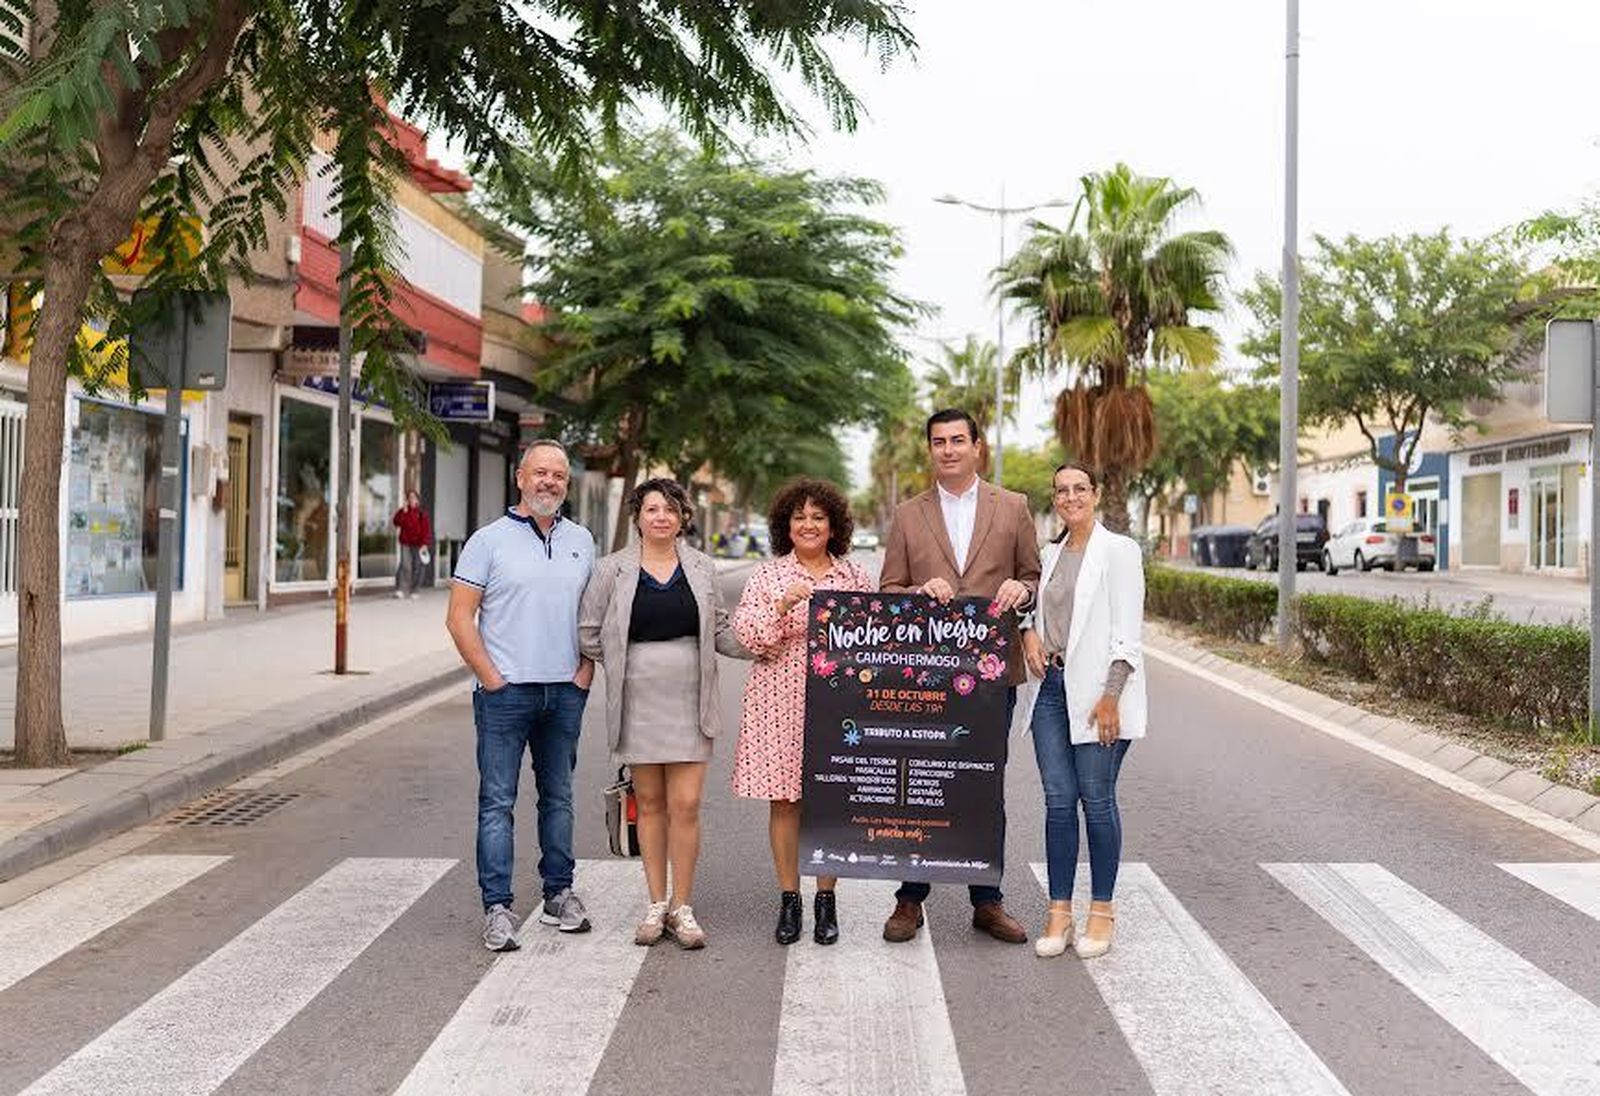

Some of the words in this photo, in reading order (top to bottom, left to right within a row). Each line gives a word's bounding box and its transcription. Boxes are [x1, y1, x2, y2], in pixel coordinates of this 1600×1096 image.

[829, 617, 891, 650] Noche
[896, 624, 921, 643] en
[928, 617, 989, 648] Negro
[855, 652, 960, 668] CAMPOHERMOSO
[866, 689, 879, 699] 31
[882, 690, 897, 700] DE
[898, 690, 947, 701] OCTUBRE
[870, 700, 903, 712] DESDE
[904, 702, 923, 712] LAS
[863, 728, 902, 738] TRIBUTO
[903, 730, 910, 738] A
[912, 730, 946, 740] ESTOPA
